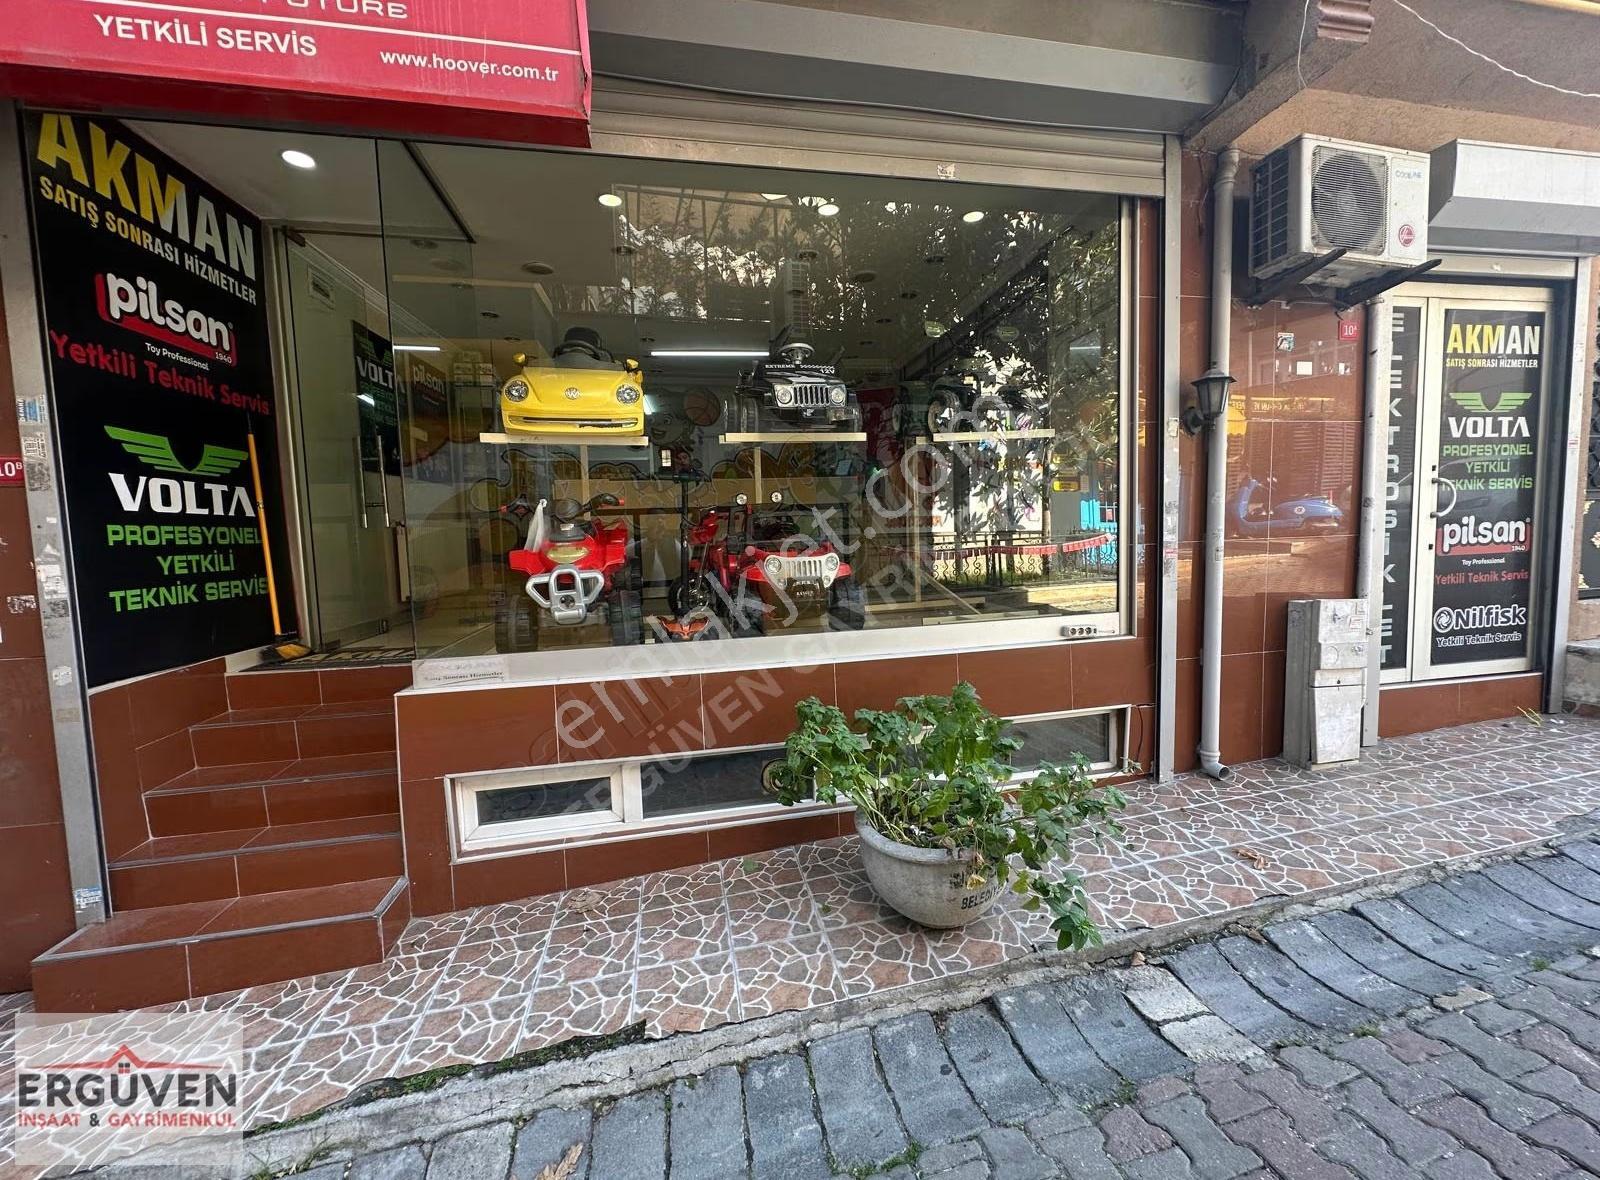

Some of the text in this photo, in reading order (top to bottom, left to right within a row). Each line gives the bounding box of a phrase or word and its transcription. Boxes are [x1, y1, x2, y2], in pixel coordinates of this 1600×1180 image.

[92, 14, 318, 57] YETKİLİ SERVİS
[380, 50, 560, 82] www.hoover.com.tr
[37, 113, 257, 282] AKMAN
[39, 176, 257, 306] SATIŞ SONRASI HİZMETLER
[106, 272, 231, 350] pilsan
[1446, 323, 1541, 355] AKMAN
[145, 342, 211, 371] Toy Professional
[1445, 357, 1539, 370] SATIŞ SONRASI HİZMETLER
[50, 329, 270, 416] Yetkili Teknik Servis
[1448, 416, 1531, 438] VOLTA
[1442, 443, 1534, 457] PROFESYONEL
[1465, 457, 1511, 474] YETKİLİ
[108, 472, 257, 518] VOLTA
[1488, 475, 1533, 490] SERVİS
[106, 523, 264, 546] PROFESYONEL
[1442, 515, 1526, 553] pilsan
[156, 549, 236, 576] YETKİLİ
[1435, 569, 1529, 585] Yetkili Teknik Servis
[109, 573, 269, 612] TEKNİK SERVİS
[1452, 603, 1528, 631] Nilfisk
[1435, 631, 1522, 648] Yetkili Teknik Servis
